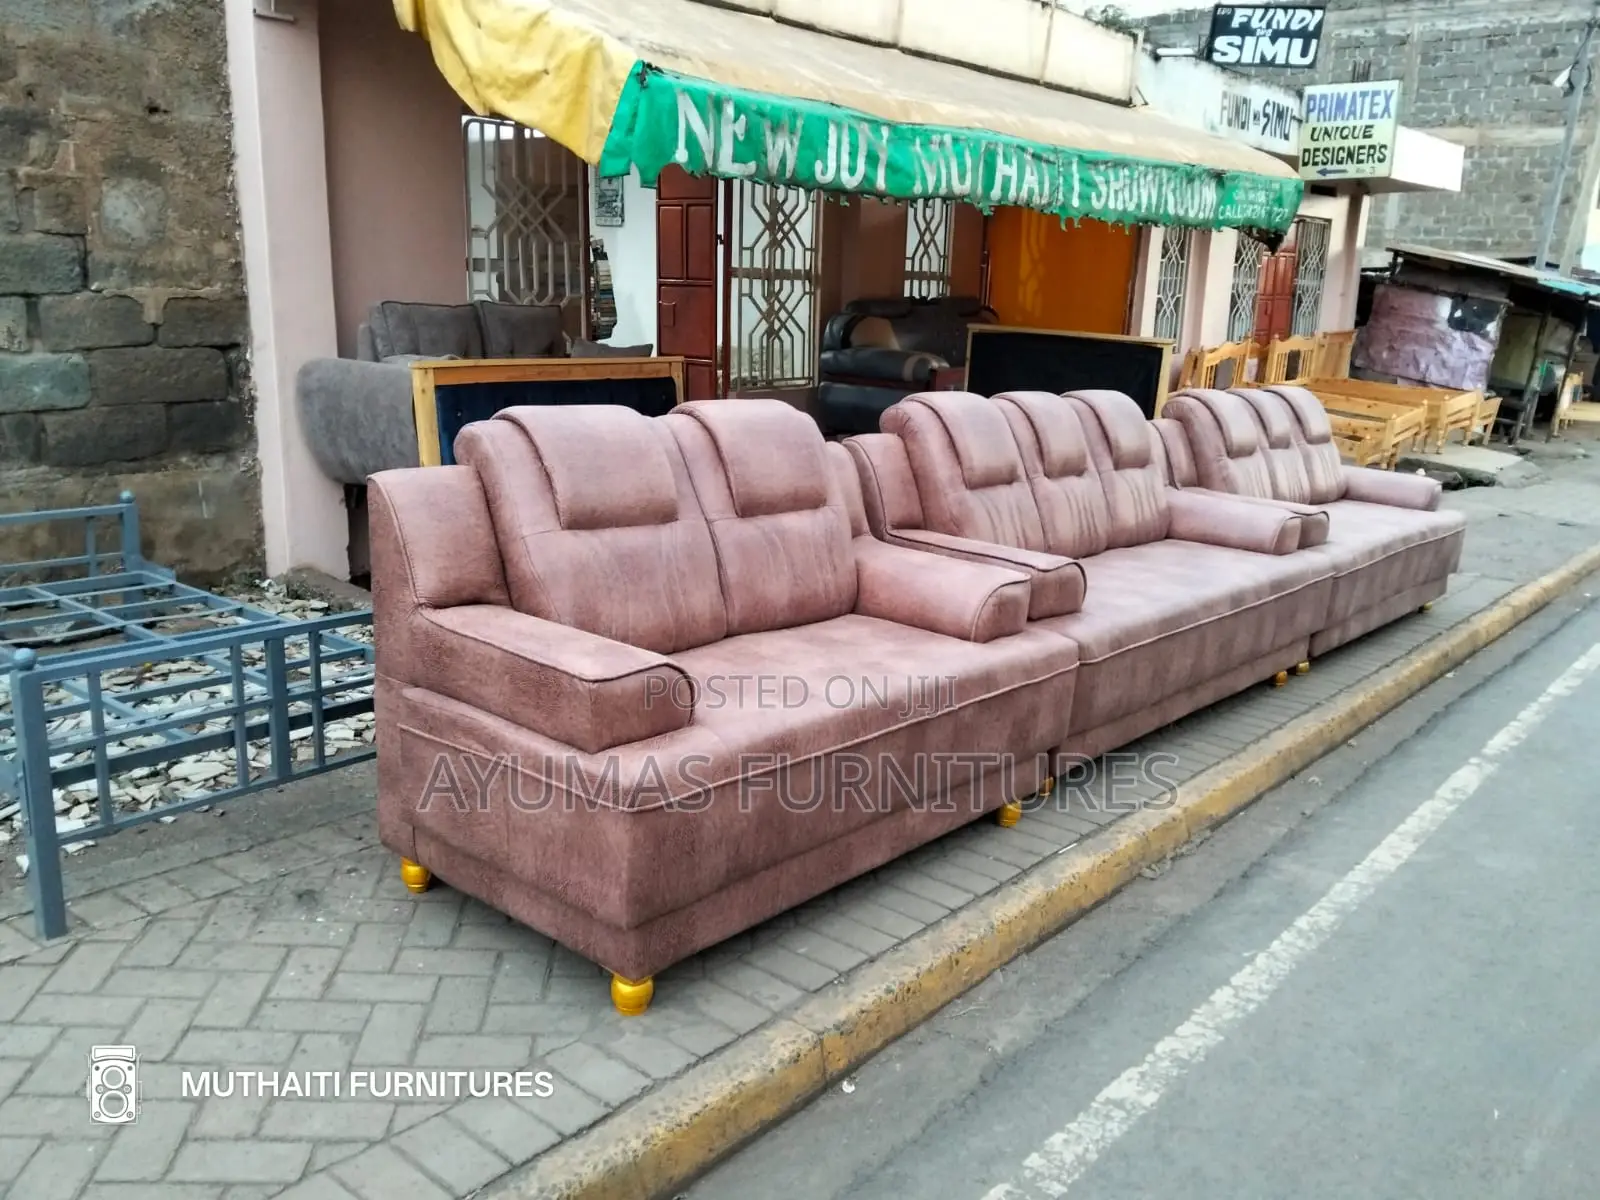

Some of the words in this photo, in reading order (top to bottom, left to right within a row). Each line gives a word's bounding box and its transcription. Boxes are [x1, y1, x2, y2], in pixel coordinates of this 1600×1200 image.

[1231, 8, 1324, 31] FUNDI
[1212, 35, 1318, 65] SIMU
[1220, 91, 1252, 132] FUNDI
[1261, 99, 1293, 141] SIMU
[1305, 89, 1395, 124] PRIMATEX
[675, 90, 804, 178] NEW
[814, 118, 890, 192] JOY
[1310, 124, 1375, 141] UNIQUE
